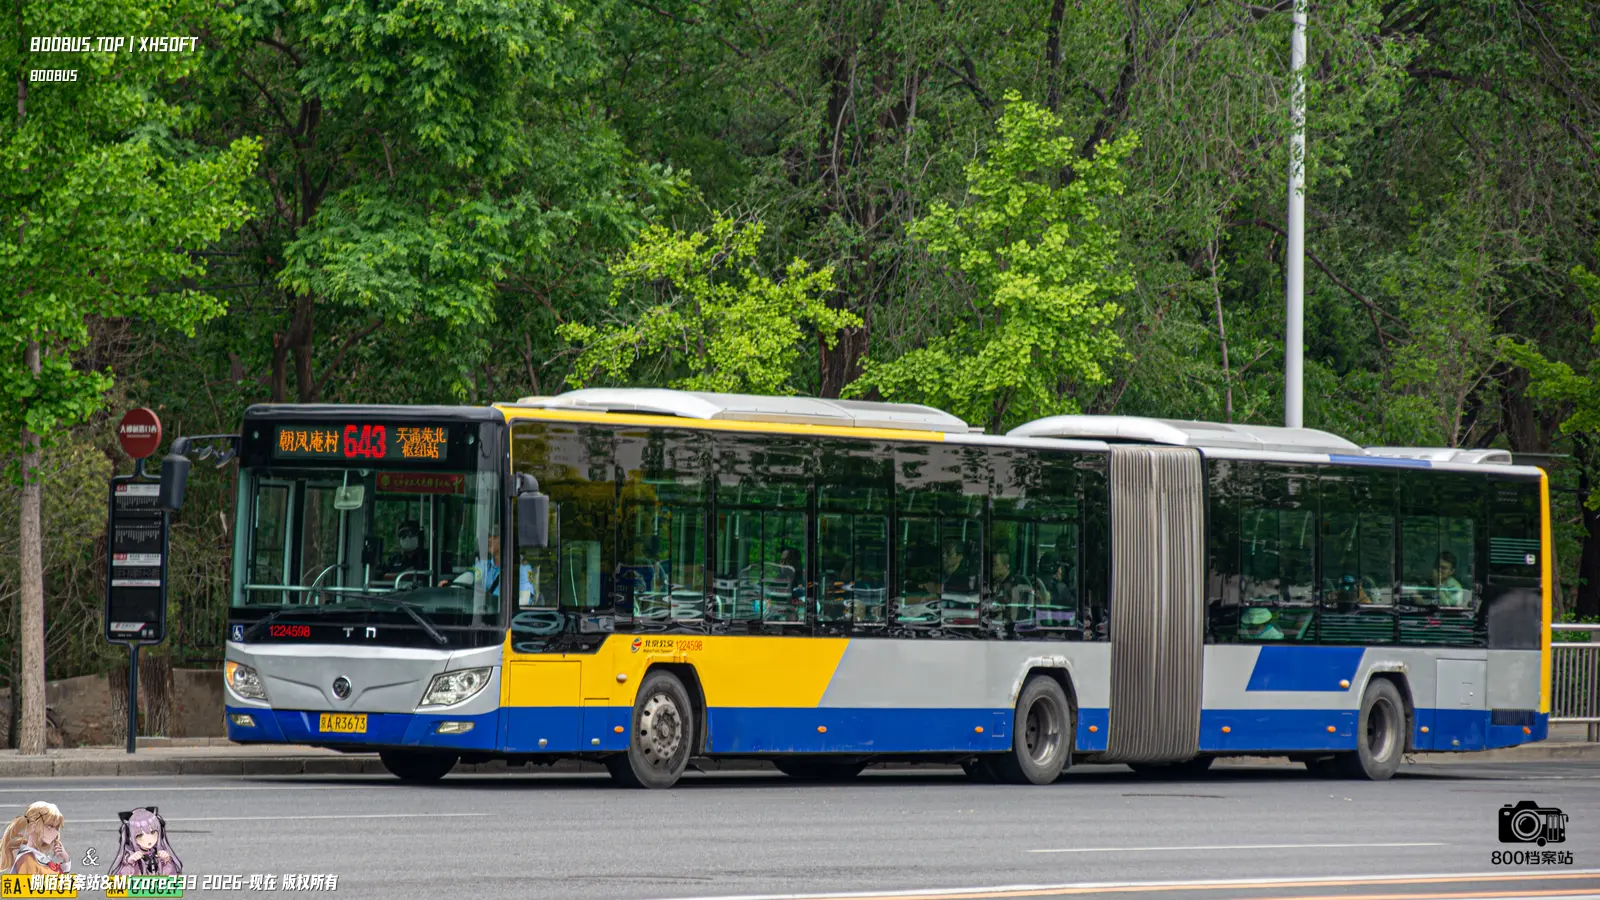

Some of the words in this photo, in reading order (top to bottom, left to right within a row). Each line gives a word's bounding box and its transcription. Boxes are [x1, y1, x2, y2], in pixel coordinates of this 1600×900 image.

[279, 429, 339, 453] 朝凤庵村
[343, 424, 387, 459] 643
[396, 427, 447, 444] 天通苑北
[402, 442, 439, 459] 枢纽站
[269, 625, 311, 638] 1224598
[645, 639, 674, 648] 北京公交
[675, 640, 703, 651] 1224598
